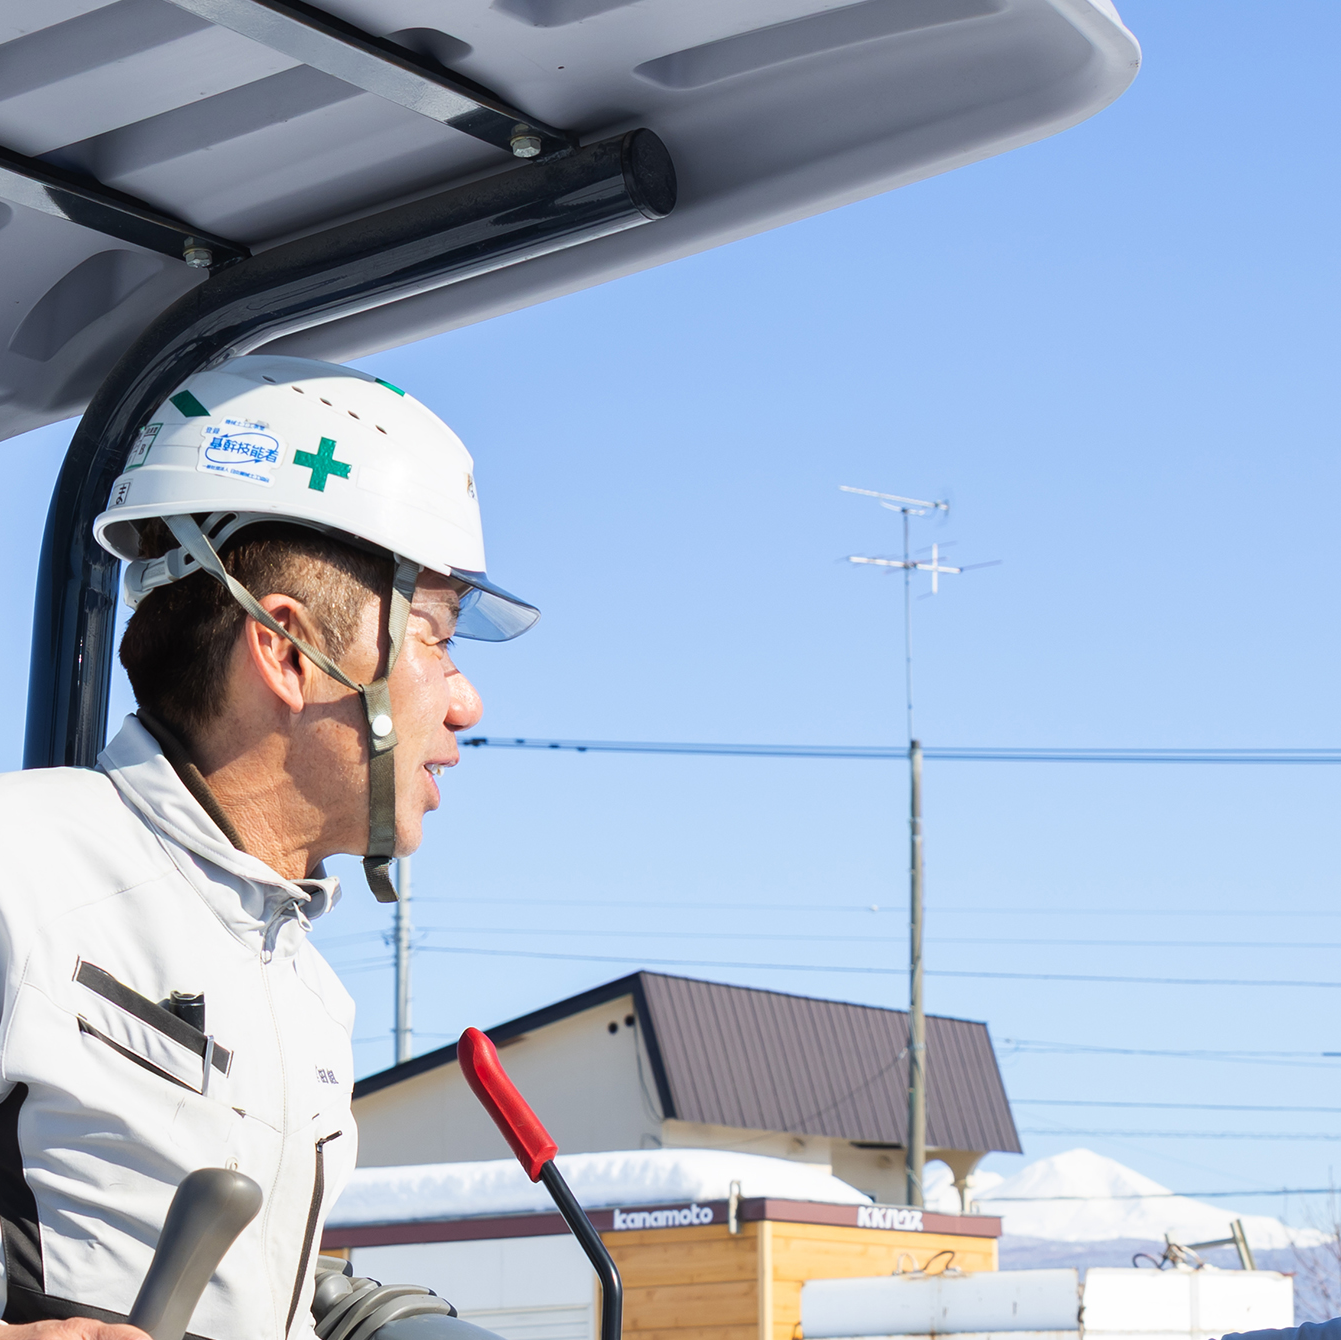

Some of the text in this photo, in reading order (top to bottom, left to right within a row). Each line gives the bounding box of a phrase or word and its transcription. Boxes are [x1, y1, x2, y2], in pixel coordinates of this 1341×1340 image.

[210, 436, 279, 463] 基幹技能者
[314, 1064, 339, 1084] 田組
[613, 1203, 714, 1231] kanamoto
